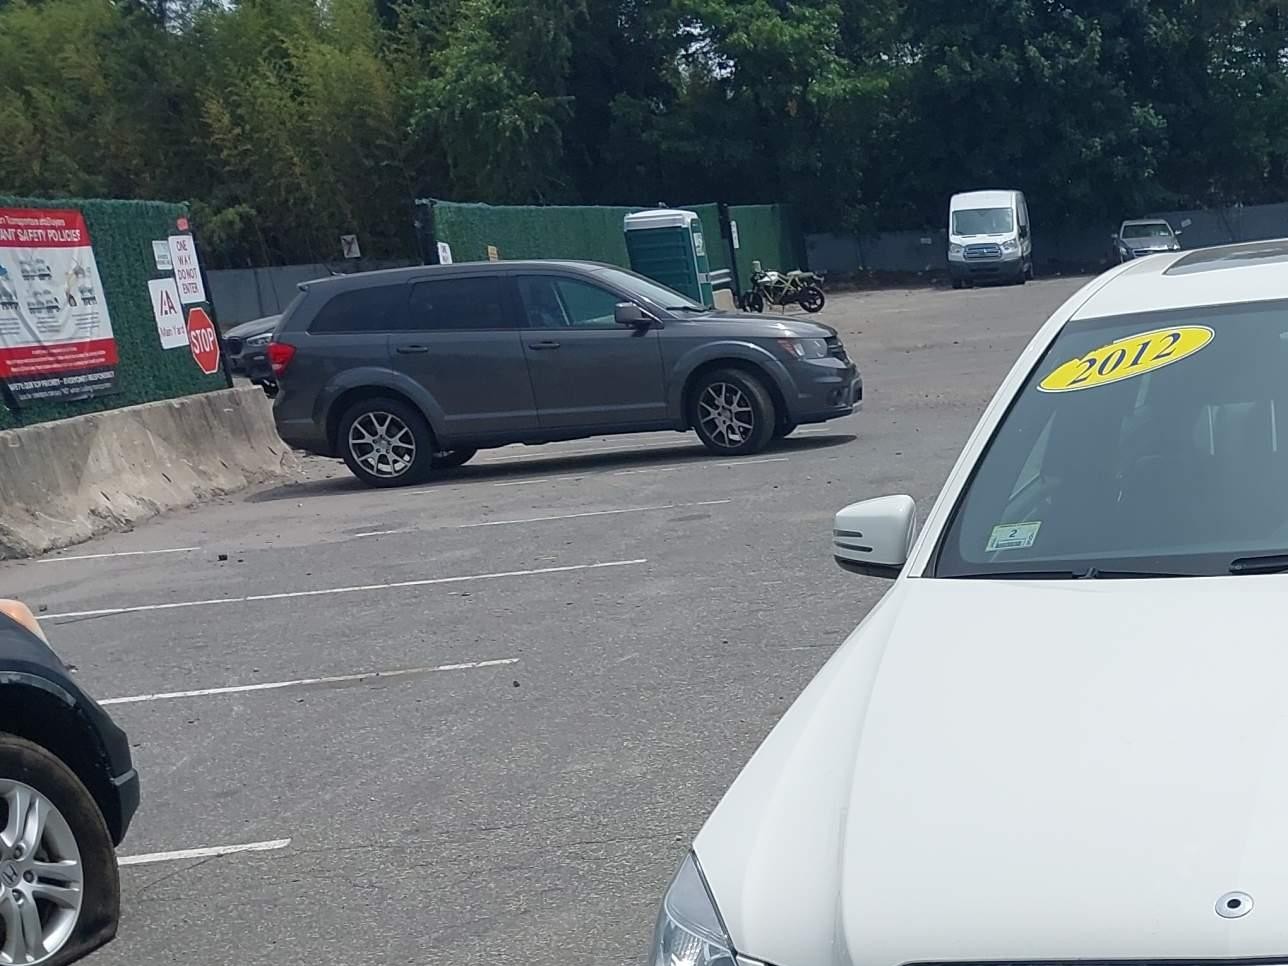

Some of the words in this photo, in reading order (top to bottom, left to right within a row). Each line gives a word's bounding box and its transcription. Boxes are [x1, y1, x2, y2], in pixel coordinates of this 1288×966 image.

[17, 229, 46, 242] SAFETY
[47, 229, 81, 242] POLICIES
[176, 240, 188, 252] ONE
[177, 255, 192, 266] WAY
[177, 269, 187, 281] DO
[187, 268, 198, 280] NOT
[182, 283, 199, 294] ENTER
[190, 327, 215, 355] STOP
[1066, 332, 1181, 387] 2012
